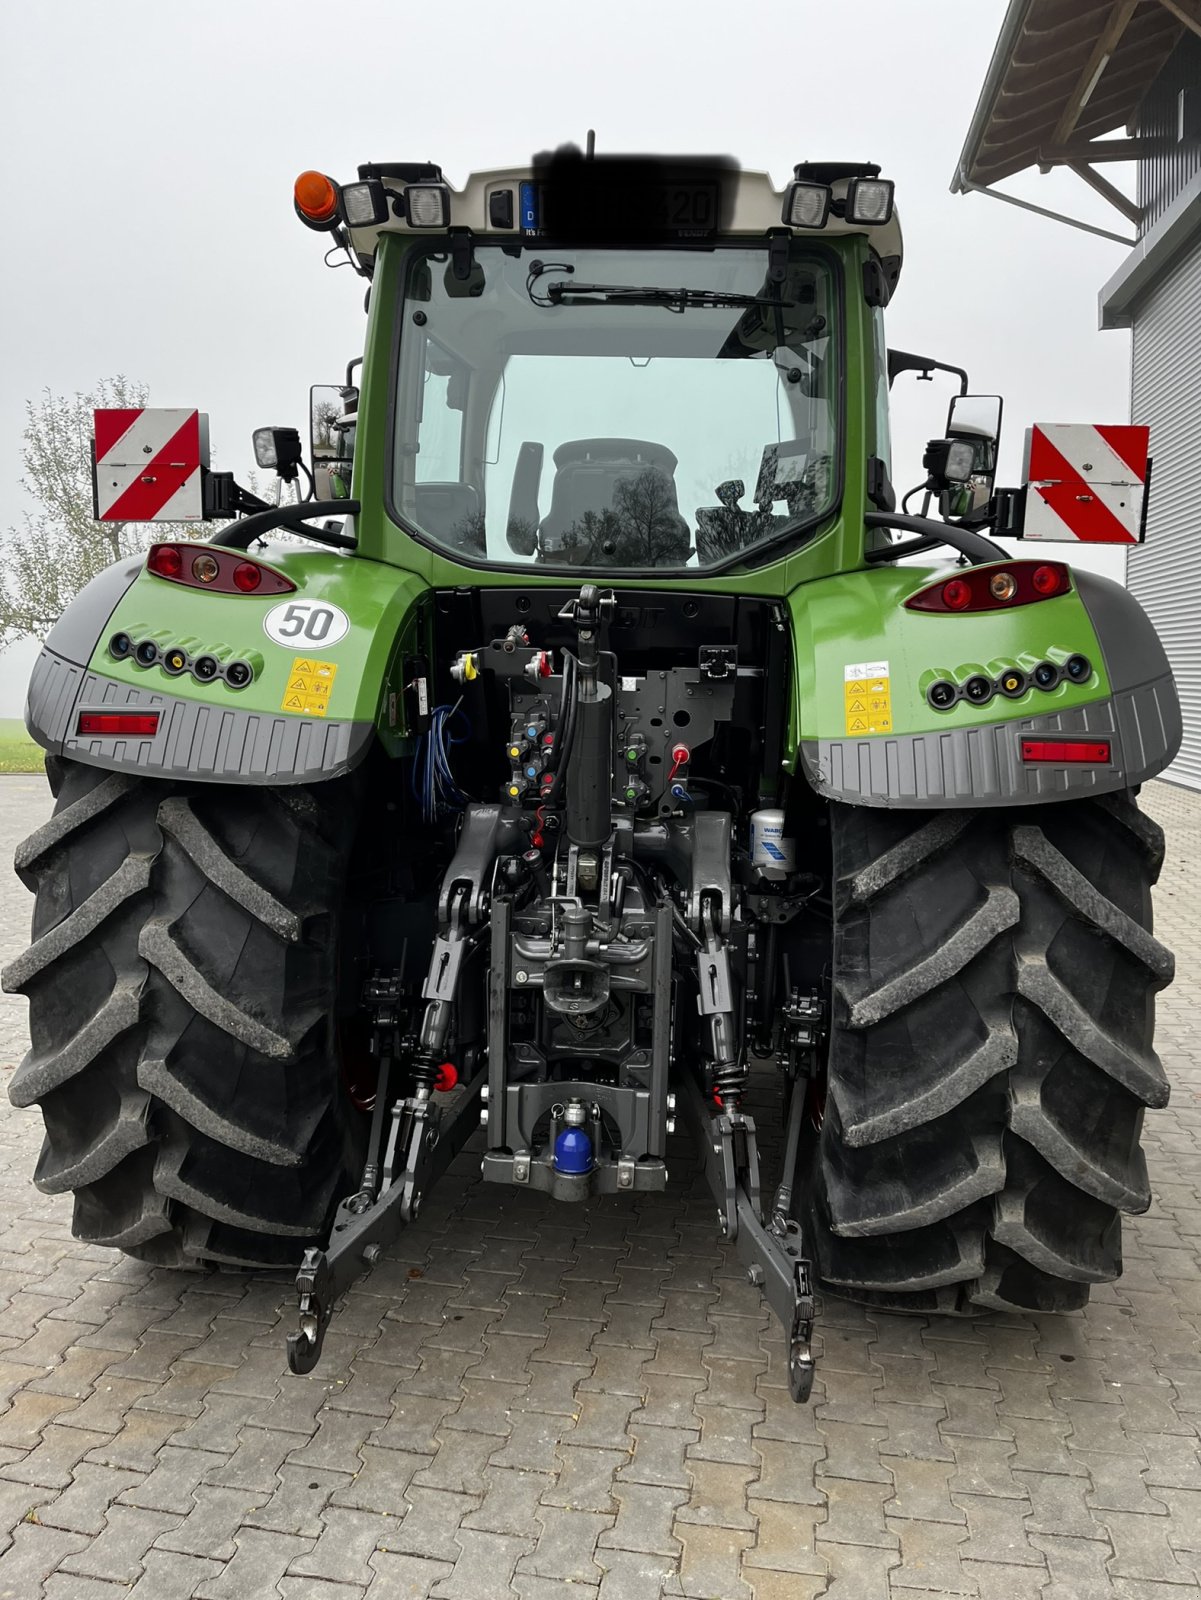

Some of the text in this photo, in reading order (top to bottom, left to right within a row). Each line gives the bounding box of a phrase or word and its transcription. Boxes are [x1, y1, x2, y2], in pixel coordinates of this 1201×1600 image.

[527, 211, 534, 220] D
[526, 228, 536, 236] It's
[279, 605, 334, 640] 50
